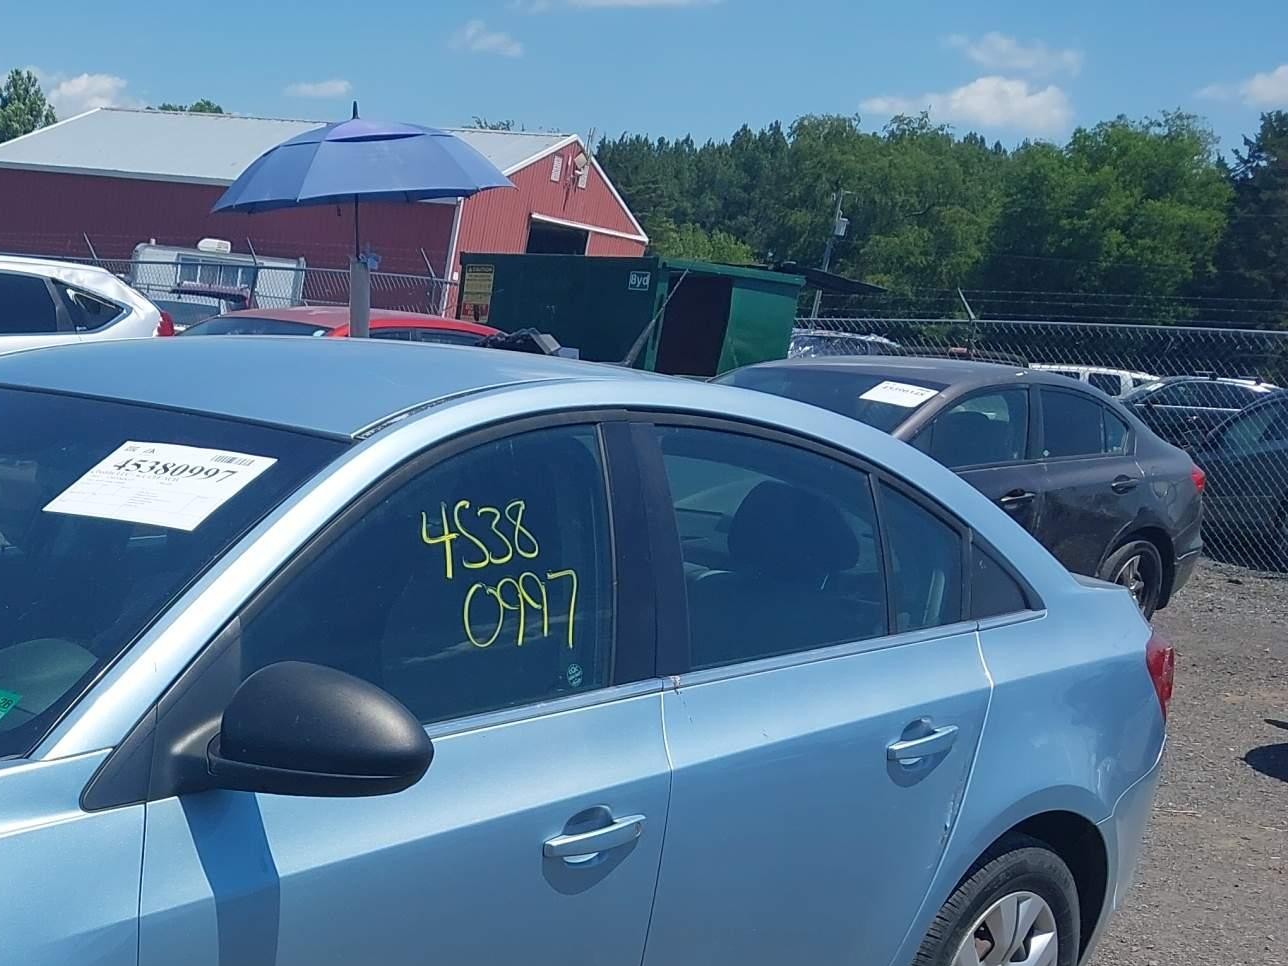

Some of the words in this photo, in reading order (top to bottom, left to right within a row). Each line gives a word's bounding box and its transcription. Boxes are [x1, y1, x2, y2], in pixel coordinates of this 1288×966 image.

[113, 457, 239, 483] 45380997
[421, 499, 539, 579] 4538
[463, 568, 578, 649] 0997
